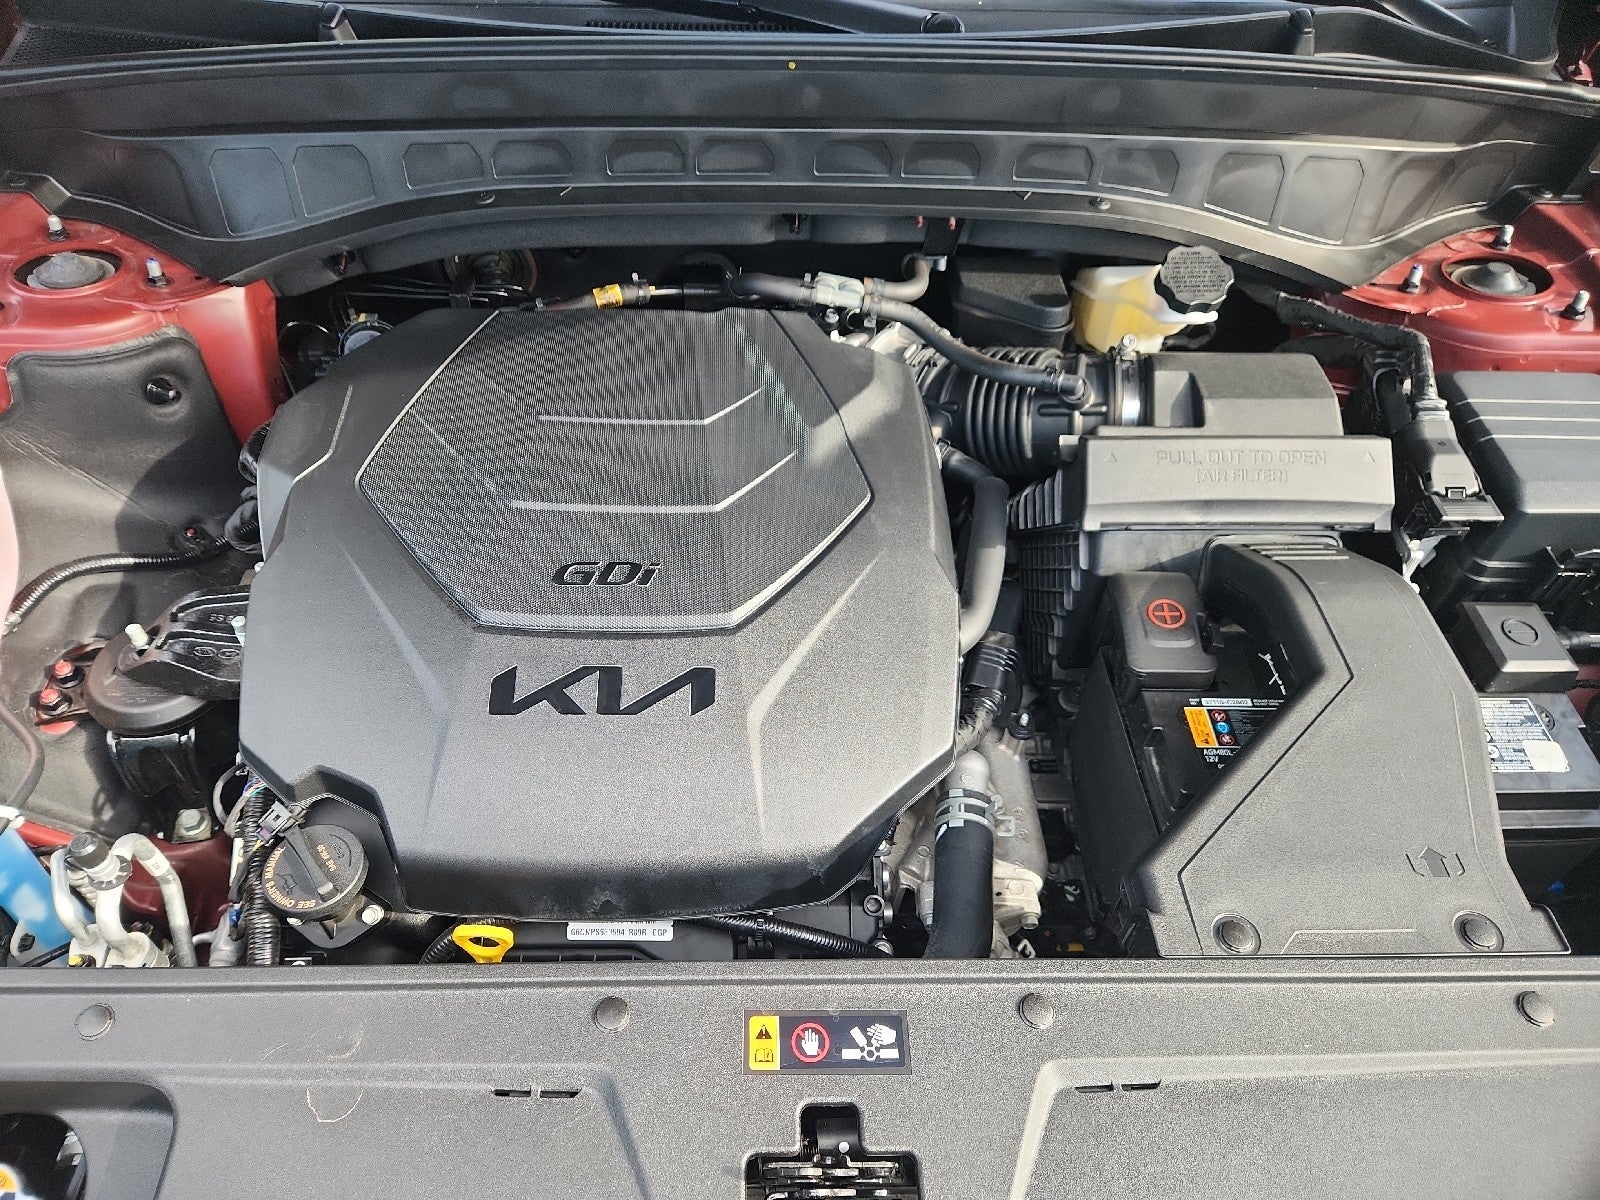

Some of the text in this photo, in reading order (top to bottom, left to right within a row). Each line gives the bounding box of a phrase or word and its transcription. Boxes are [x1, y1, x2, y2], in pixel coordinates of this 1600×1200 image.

[1155, 449, 1327, 465] PULL OUT TO OPEN
[296, 899, 316, 909] SEE
